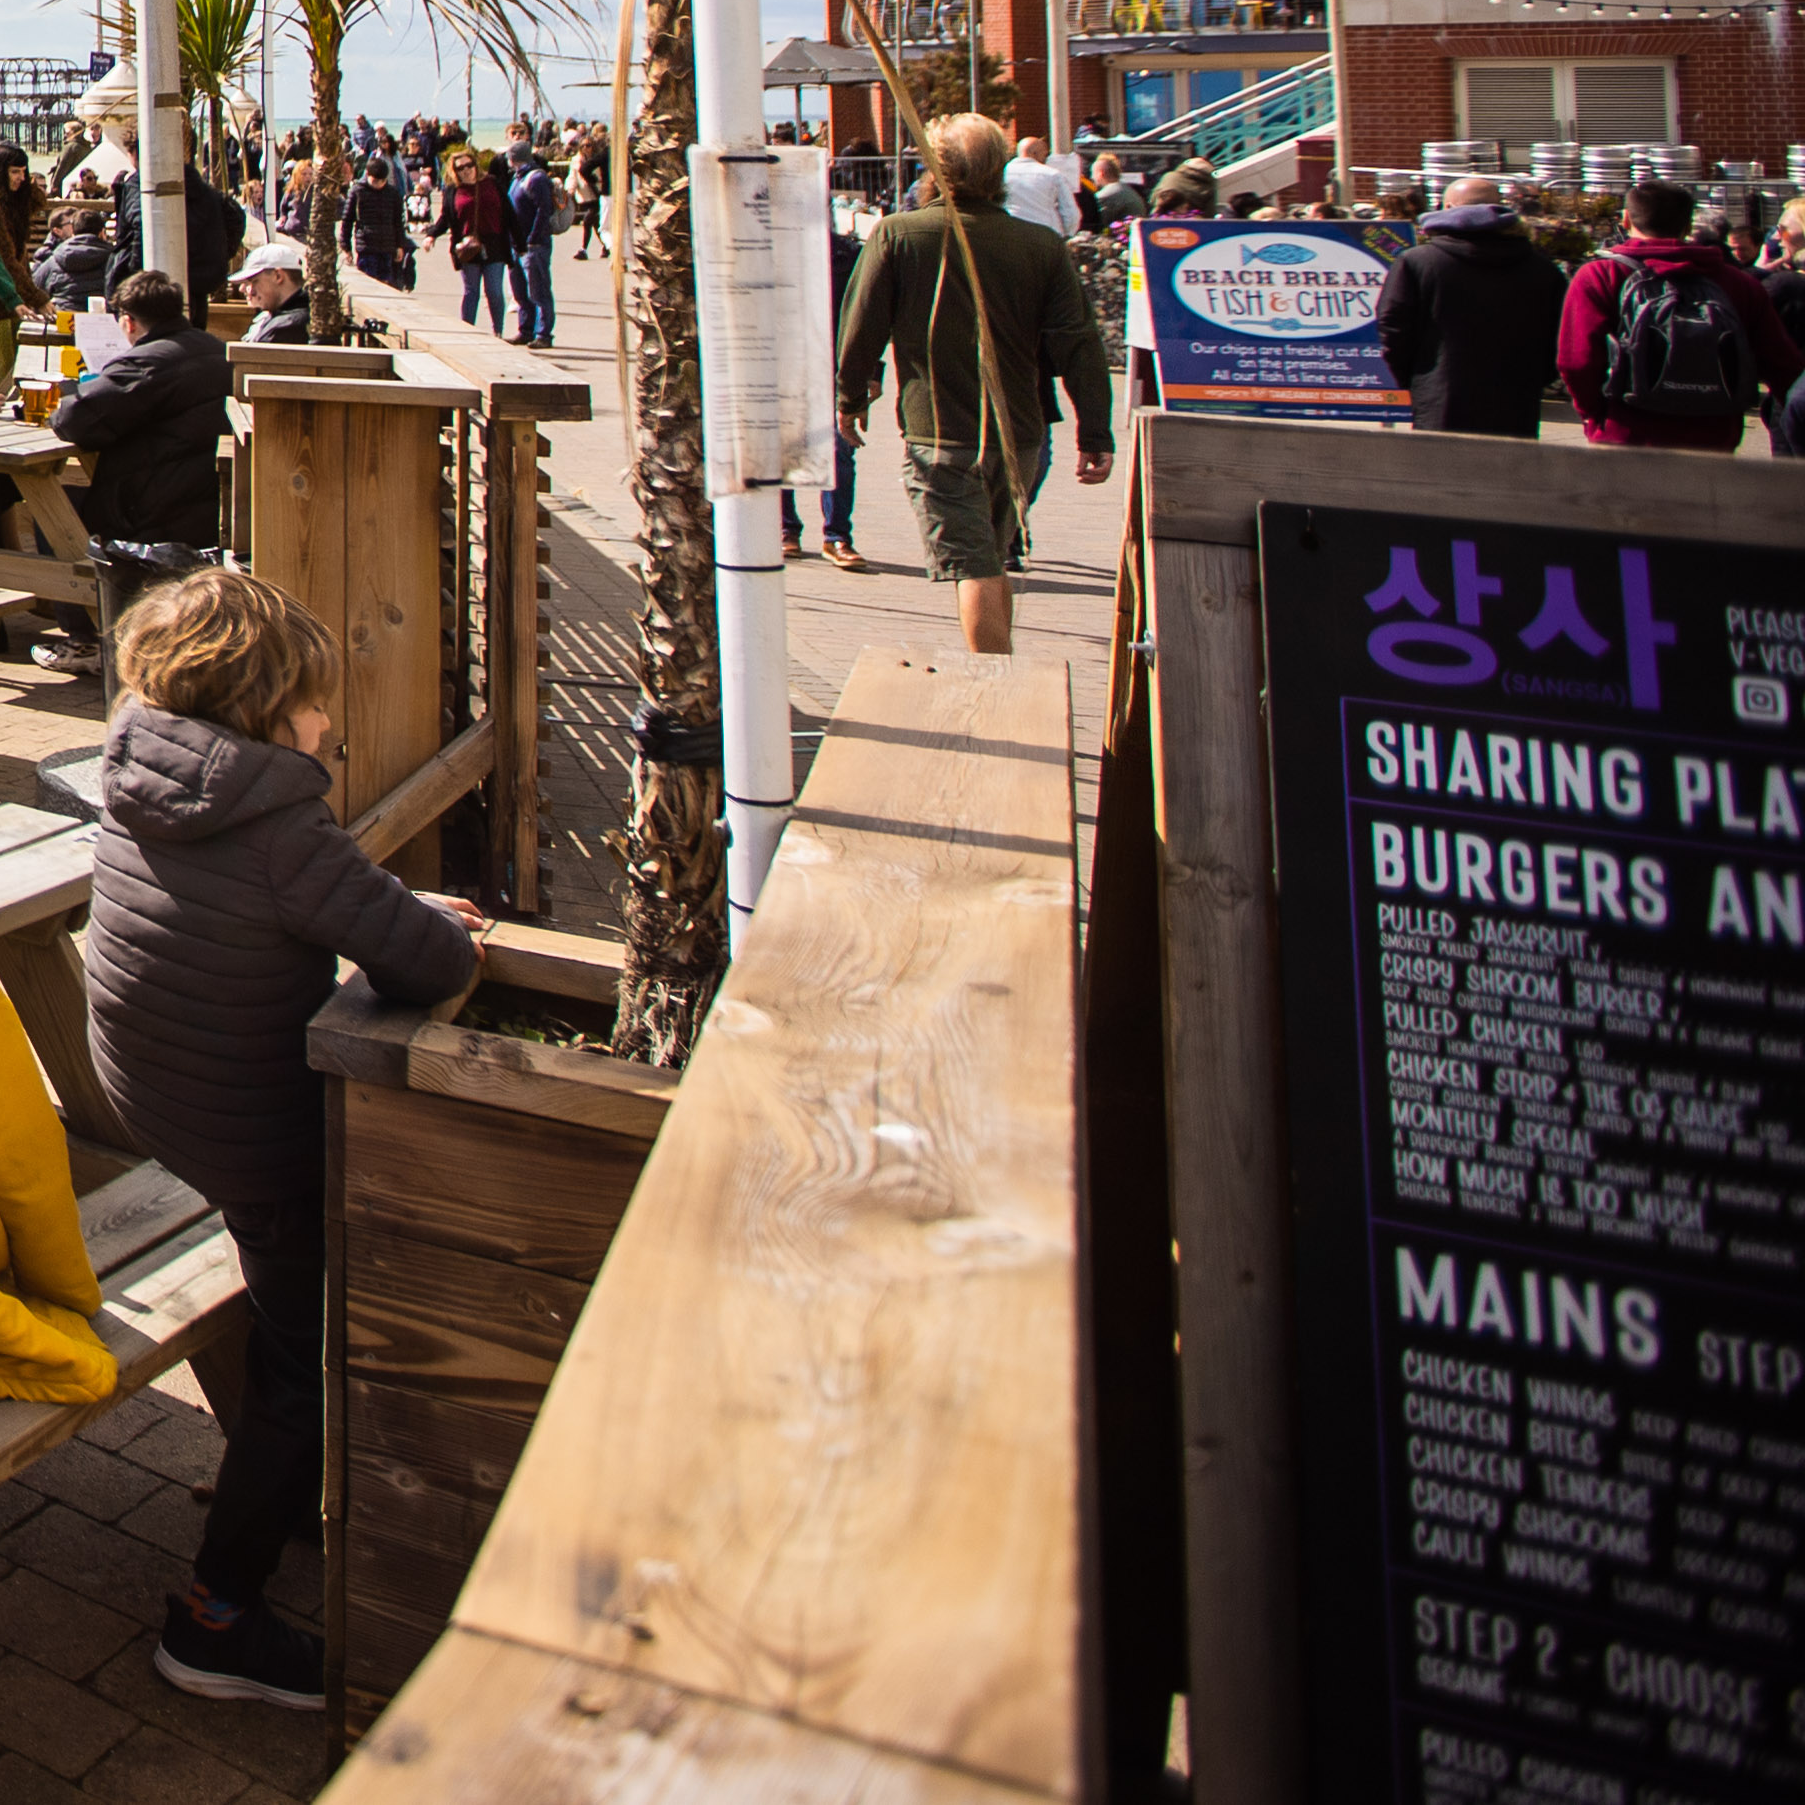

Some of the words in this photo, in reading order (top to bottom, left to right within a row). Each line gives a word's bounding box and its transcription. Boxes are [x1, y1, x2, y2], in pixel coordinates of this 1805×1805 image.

[1182, 269, 1275, 286] BEACH
[1283, 270, 1385, 288] BREAK
[1206, 288, 1262, 316] FISH
[1269, 291, 1293, 312] &
[1296, 290, 1373, 318] CHIPS
[1190, 342, 1217, 356] Our
[1219, 343, 1256, 358] chips
[1258, 346, 1283, 357] are
[1284, 344, 1334, 361] freshly
[1335, 346, 1359, 358] cut
[1211, 369, 1231, 381] All
[1231, 372, 1257, 382] our
[1258, 370, 1284, 383] fish
[1287, 372, 1298, 383] is
[1299, 371, 1327, 384] line
[1328, 373, 1383, 388] caught.
[1237, 359, 1257, 368] on
[1258, 358, 1282, 369] the
[1284, 359, 1352, 376] premises.
[1364, 539, 1677, 710] 상사
[1501, 671, 1628, 707] (SANGSA)
[1365, 720, 1644, 817] SHARING
[1371, 821, 1667, 927] BURGERS
[1378, 902, 1456, 938] PULLED
[1470, 916, 1589, 959] JACKFRUIT
[1380, 932, 1431, 953] SMOKEY
[1381, 952, 1454, 988] CRISPY
[1467, 965, 1561, 1005] SHROOM
[1574, 980, 1662, 1020] BURGER
[1384, 1000, 1458, 1036] PULLED
[1471, 1013, 1562, 1054] CHICKEN
[1386, 1030, 1438, 1052] SMOKEY
[1387, 1050, 1478, 1090] CHICKEN
[1494, 1067, 1557, 1101] STRIP
[1583, 1080, 1622, 1113] THE
[1443, 1089, 1500, 1112] CHICKEN
[1391, 1099, 1497, 1143] MONTHLY
[1512, 1119, 1596, 1159] SPECIAL
[1394, 1149, 1447, 1185] HOW
[1458, 1160, 1528, 1199] MUCH
[1539, 1174, 1565, 1205] IS
[1572, 1180, 1619, 1214] TOO
[1632, 1191, 1704, 1231] MUCH
[1396, 1179, 1451, 1205] CHICKEN
[1395, 1245, 1661, 1366] MAINS
[1697, 1329, 1802, 1395] STEP
[1402, 1347, 1512, 1404] CHICKEN
[1526, 1376, 1617, 1427] WINGS
[1403, 1392, 1510, 1446] CHICKEN
[1527, 1419, 1600, 1465] BITES
[1407, 1433, 1523, 1491] CHICKEN
[1540, 1462, 1652, 1521] TENDERS
[1410, 1476, 1501, 1530] CRISPY
[1514, 1501, 1652, 1564] SHROOMS
[1413, 1519, 1485, 1567] CAULI
[1414, 1595, 1519, 1665] STEP
[1534, 1622, 1559, 1680] 2
[1604, 1641, 1761, 1727] CHOOSE
[1417, 1653, 1506, 1704] SESAME
[1420, 1727, 1509, 1779] PULLED
